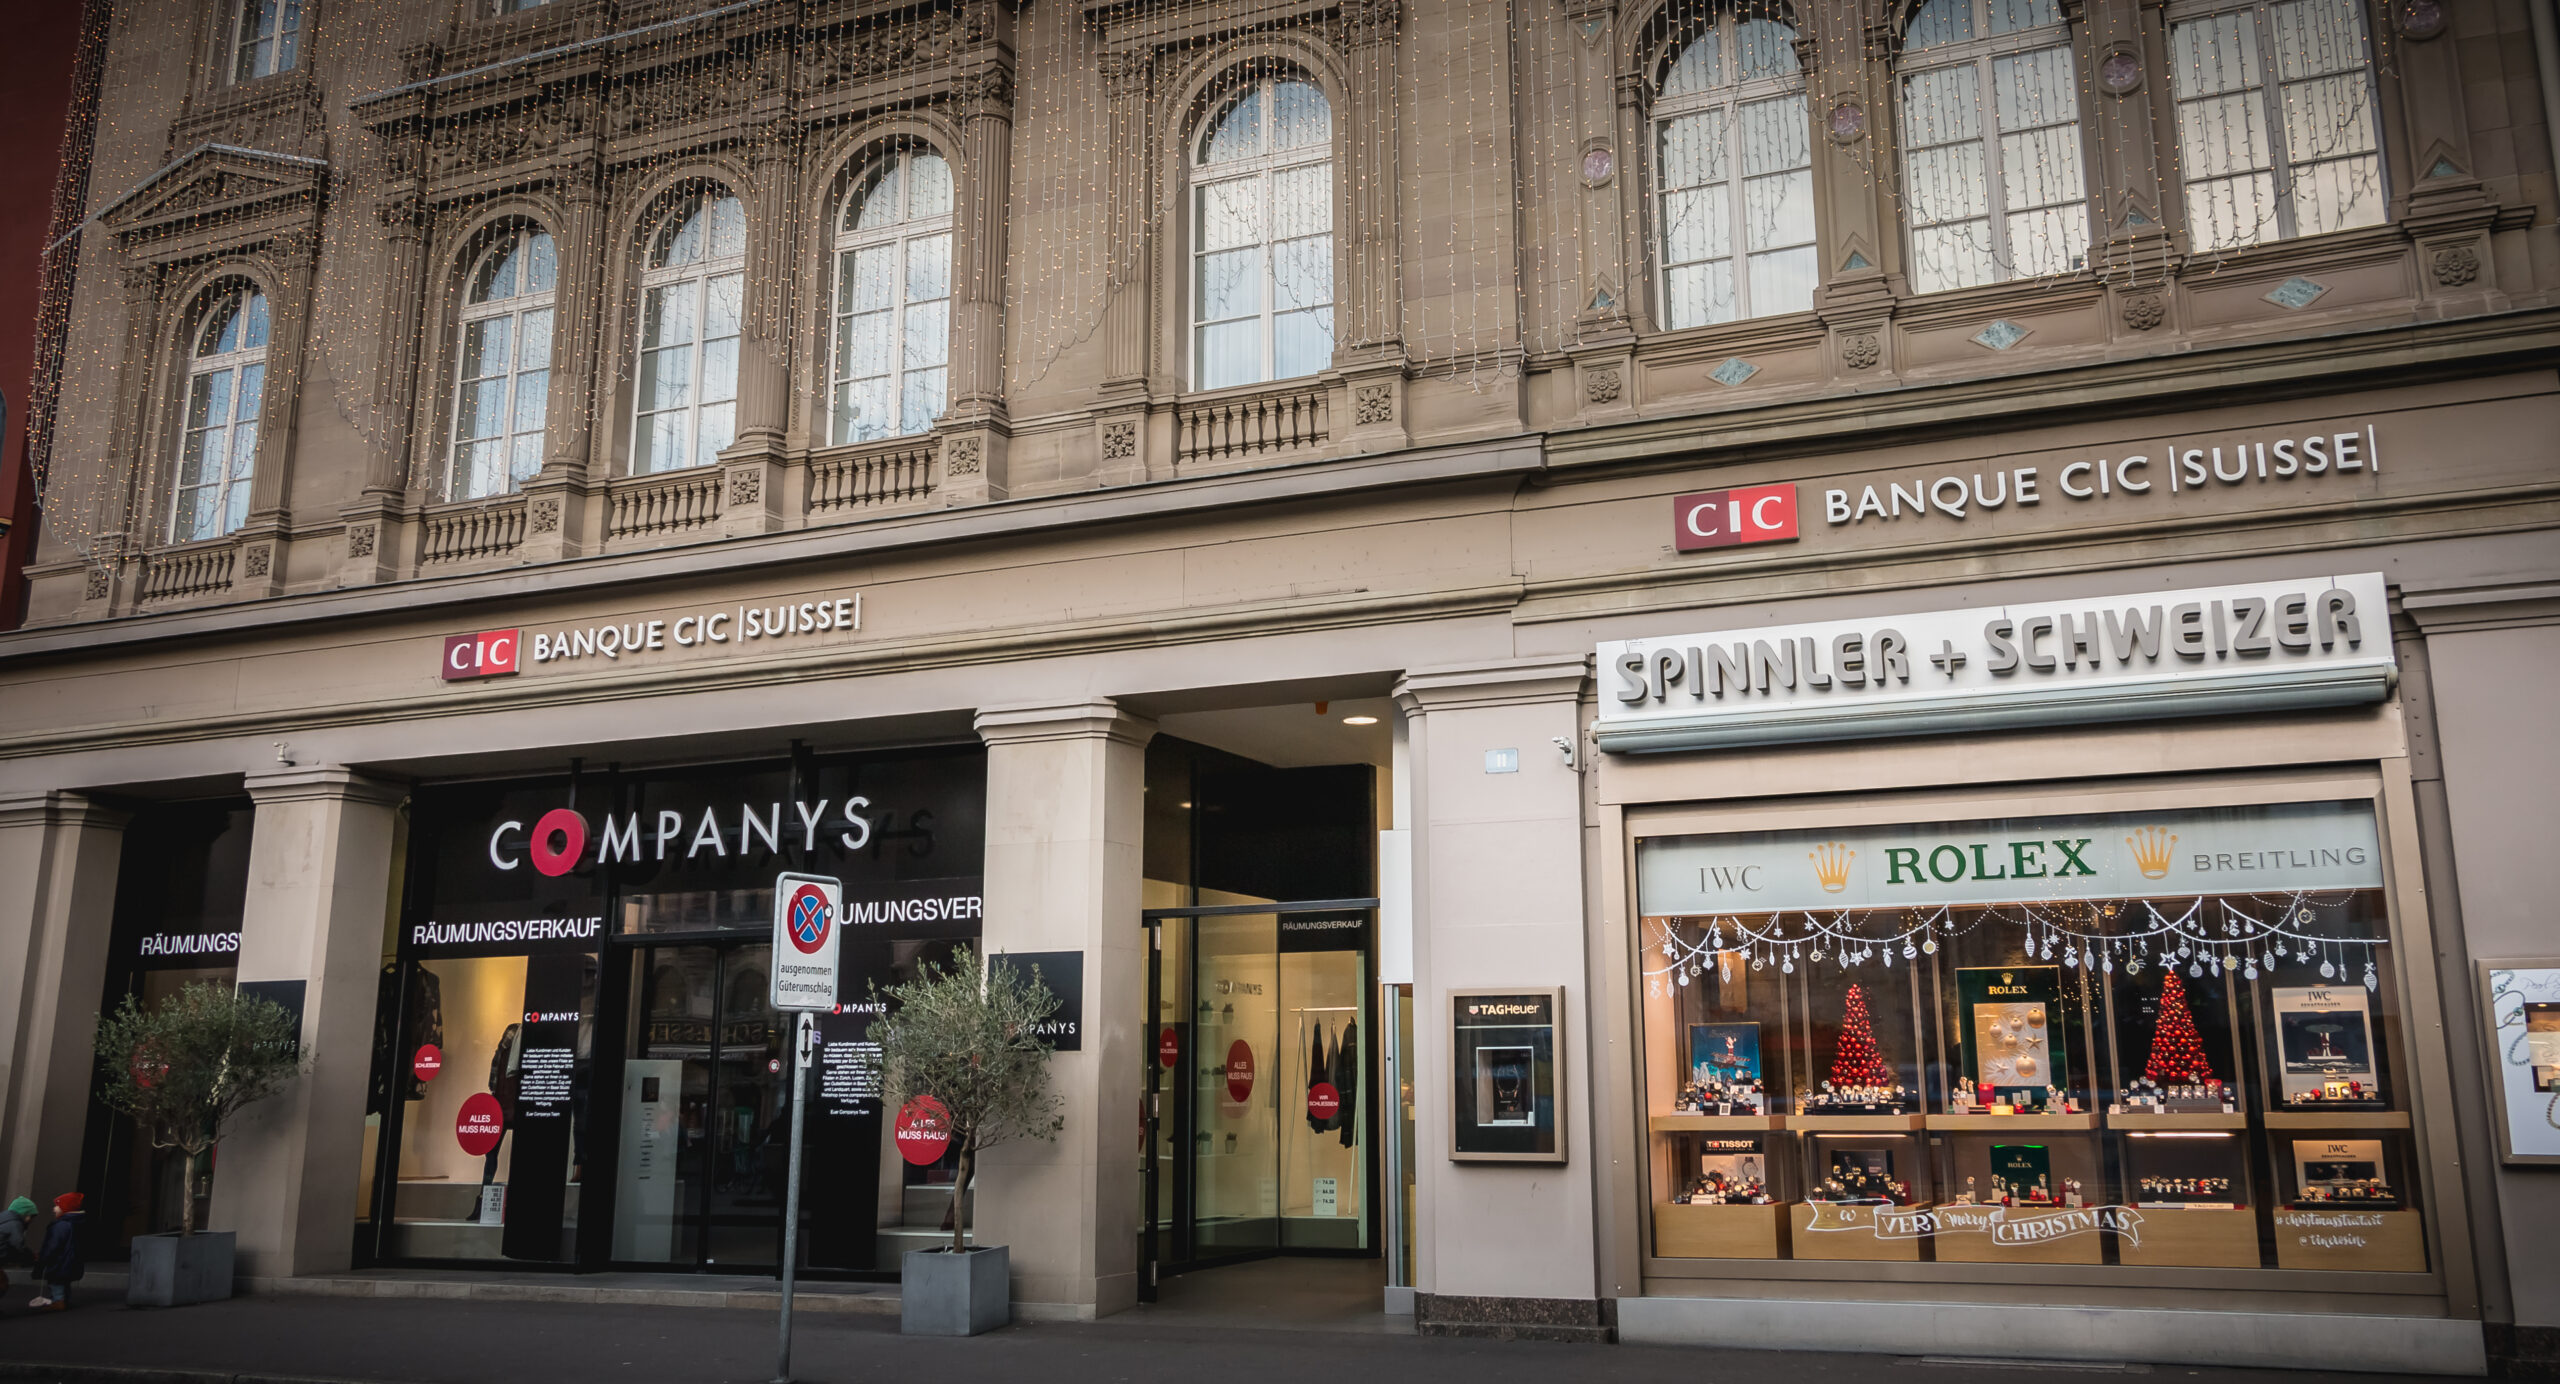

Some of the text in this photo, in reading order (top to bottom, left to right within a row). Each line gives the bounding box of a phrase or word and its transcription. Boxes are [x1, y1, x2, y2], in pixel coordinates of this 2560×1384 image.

[1825, 467, 2040, 523] BANQUE
[2059, 455, 2151, 497] CIC
[1687, 496, 1783, 537] CIC
[534, 620, 664, 659] BANQUE
[673, 612, 728, 645] CIC
[1615, 628, 1910, 702] SPINNLER
[1984, 588, 2362, 673] SCHWEIZER
[450, 638, 511, 670] CIC
[490, 796, 872, 877] COMPANYS
[1885, 838, 2097, 884] ROLEX
[2193, 847, 2366, 873] BREITLING
[1699, 864, 1764, 893] IWC
[413, 917, 601, 945] RÄUMUNGSVERKAUF
[1282, 920, 1363, 931] RÄUMUNGSVERKAUF
[780, 964, 832, 977] ausgenommen
[779, 980, 832, 996] Güterumschlag
[1988, 985, 2028, 995] ROLEX
[2308, 991, 2331, 1001] IWC
[524, 1011, 579, 1023] COMPANYS
[459, 1125, 500, 1134] MUSS RAUS!
[469, 1115, 490, 1123] ALLES
[898, 1131, 922, 1140] MUSS
[2327, 1144, 2348, 1153] IWC
[1881, 1213, 1943, 1234] VERY
[1997, 1211, 2131, 1242] CHRISTMAS
